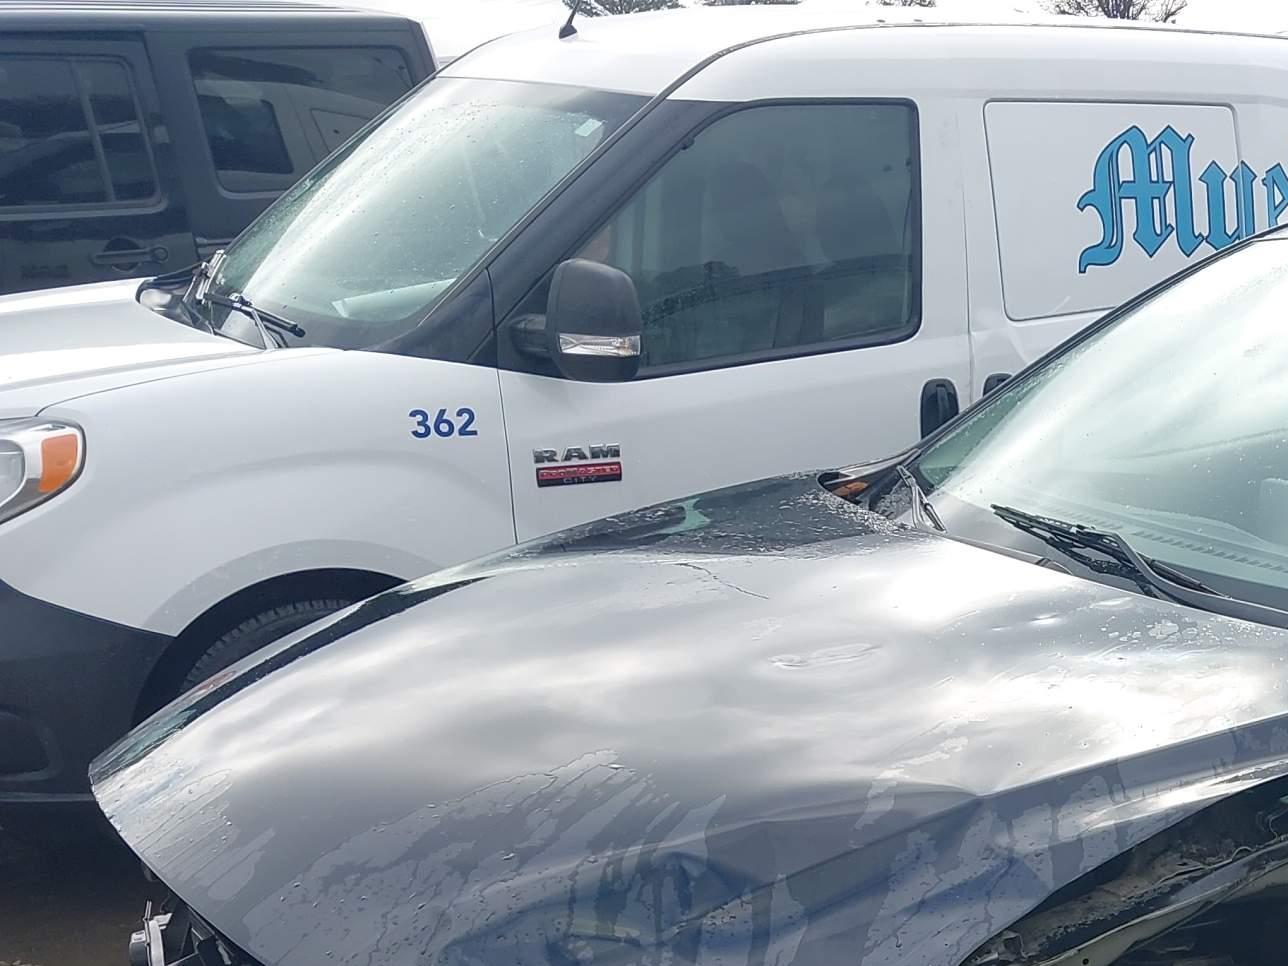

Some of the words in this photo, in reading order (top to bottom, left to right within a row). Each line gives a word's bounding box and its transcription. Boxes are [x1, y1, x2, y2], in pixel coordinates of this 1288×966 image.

[409, 408, 477, 438] 362
[532, 443, 620, 464] RAM
[563, 476, 597, 485] CITY
